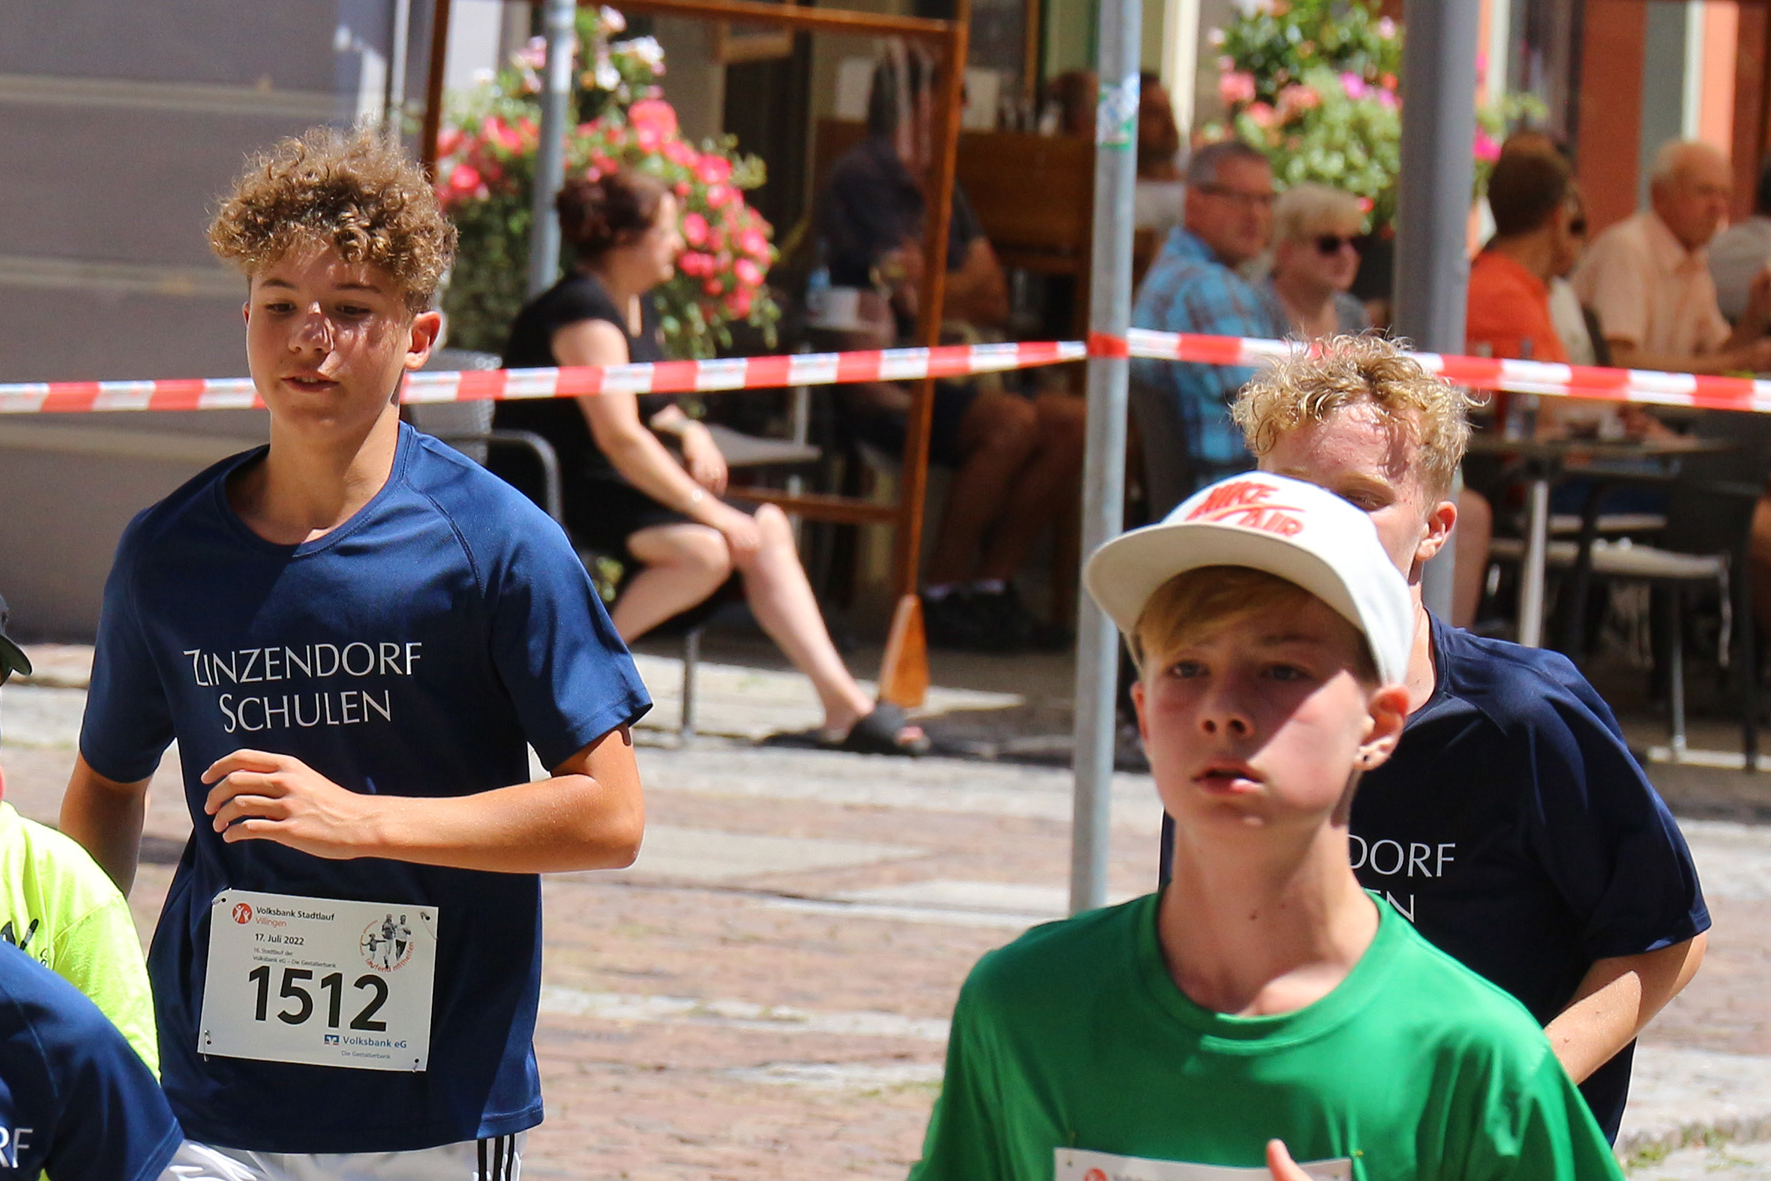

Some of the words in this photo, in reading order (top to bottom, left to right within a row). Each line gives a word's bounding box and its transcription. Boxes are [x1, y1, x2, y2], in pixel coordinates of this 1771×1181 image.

[1236, 507, 1304, 537] AIR
[183, 641, 423, 687] ZINZENDORF
[218, 690, 392, 734] SCHULEN
[255, 916, 288, 928] Villingen
[256, 906, 296, 918] Volksbank
[298, 910, 335, 921] Stadtlauf
[255, 933, 266, 942] 17.
[267, 934, 282, 944] Juli
[284, 936, 305, 946] 2022
[248, 964, 389, 1032] 1512
[342, 1036, 392, 1048] Volksbank
[394, 1040, 407, 1049] eG
